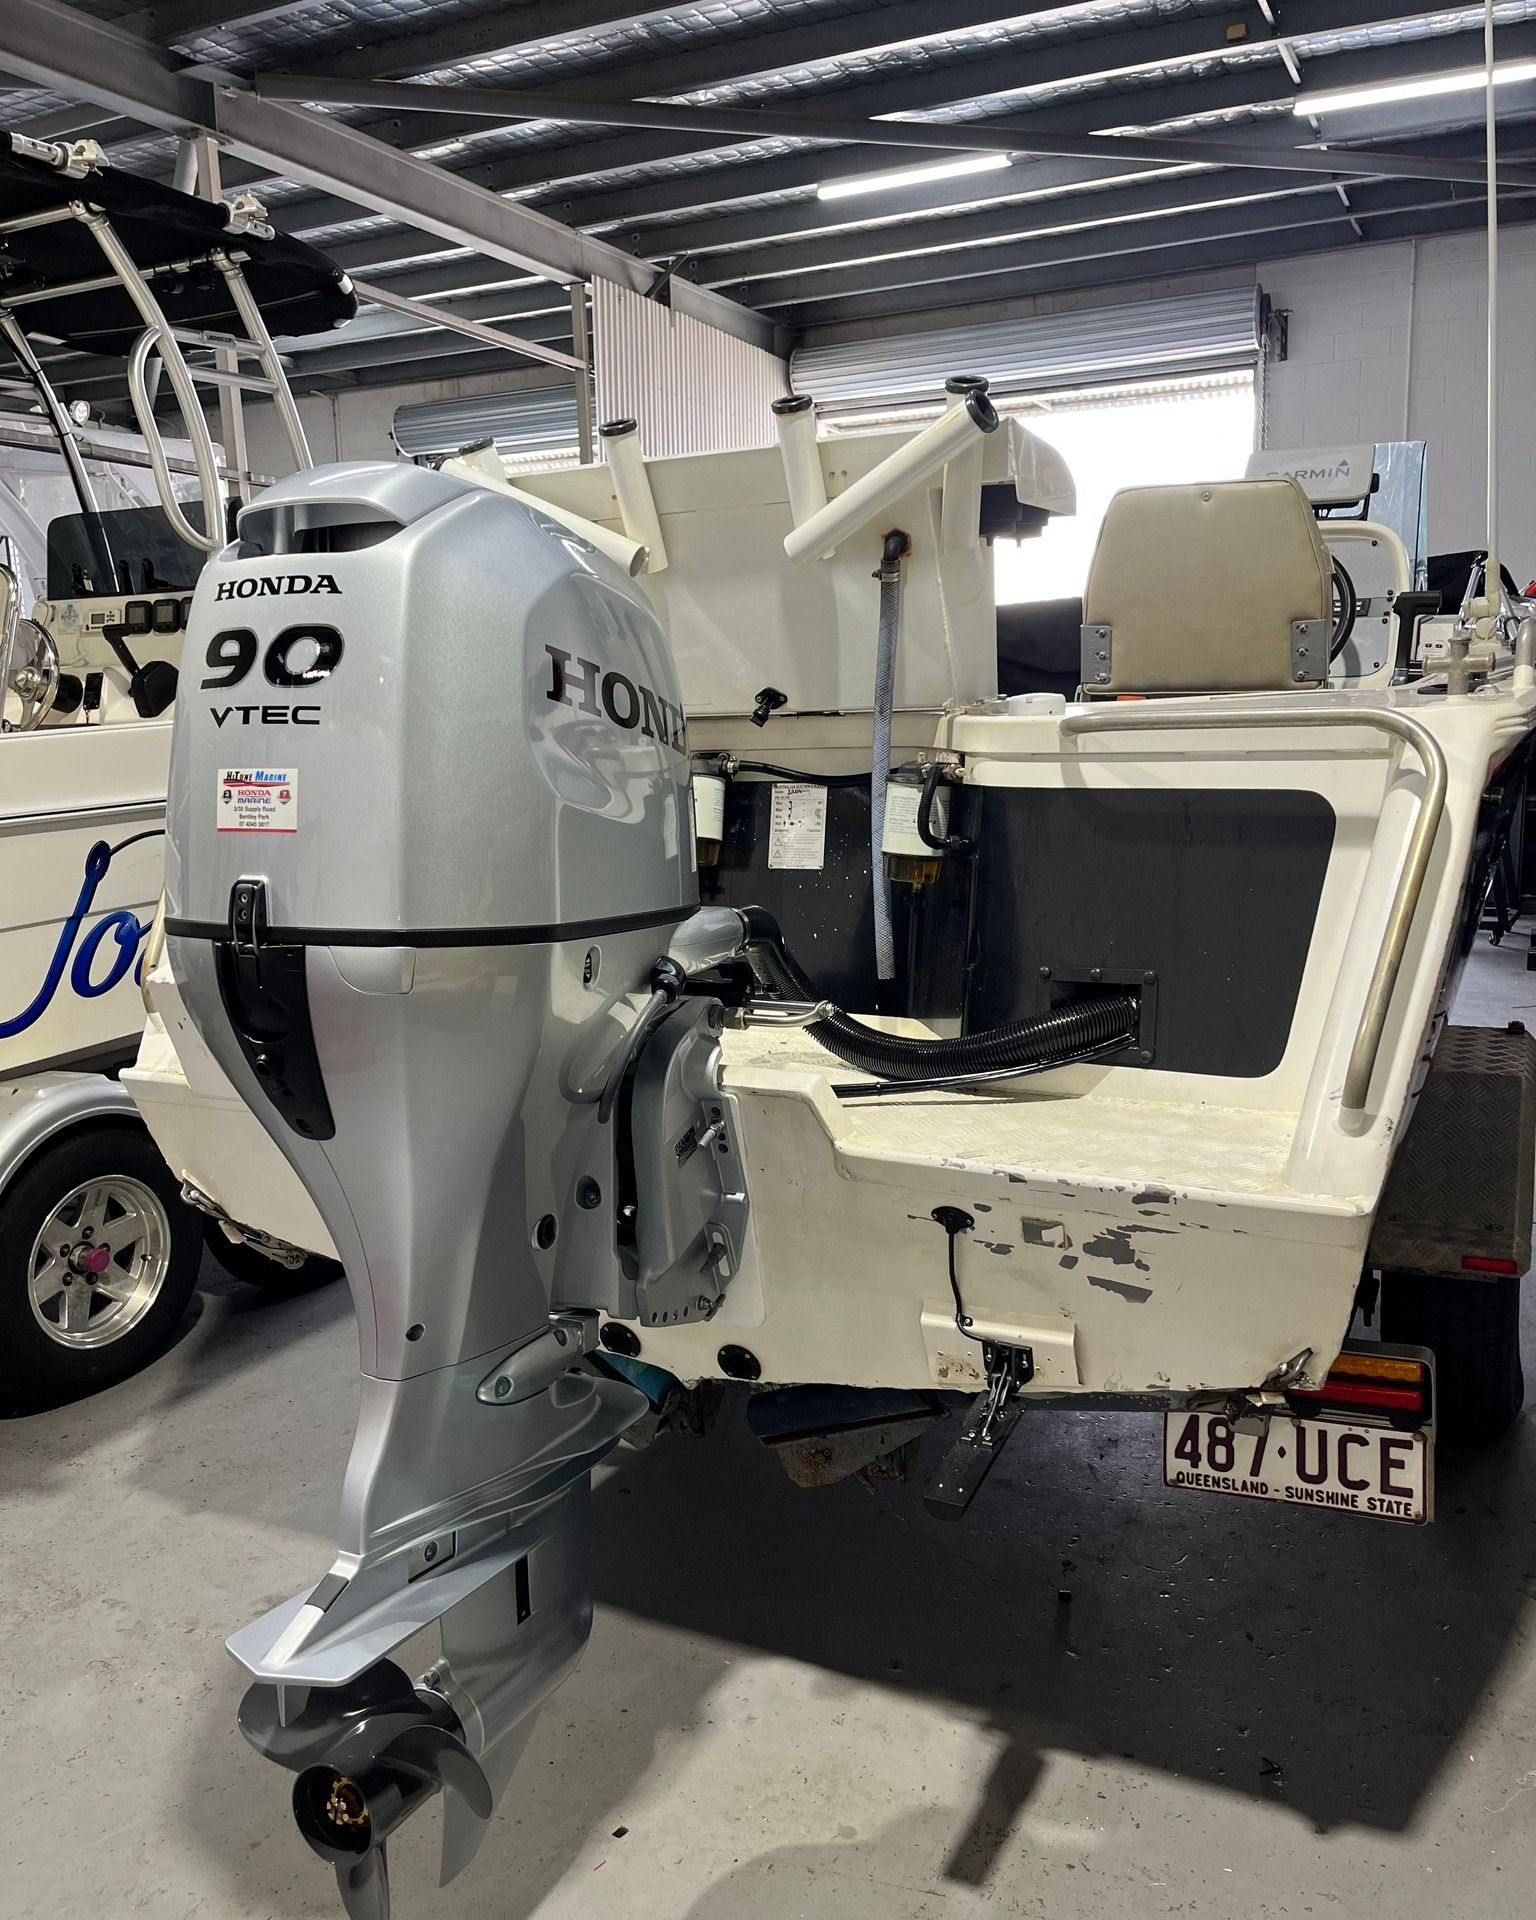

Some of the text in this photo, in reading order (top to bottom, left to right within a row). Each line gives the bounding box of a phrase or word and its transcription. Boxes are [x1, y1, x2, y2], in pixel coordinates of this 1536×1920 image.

[214, 574, 343, 602] HONDA
[200, 623, 346, 690] 90
[209, 705, 322, 729] VTEC
[1175, 1470, 1269, 1496] QUEENSLAND
[1284, 1485, 1360, 1510] SUNSHINE
[1366, 1496, 1413, 1517] STATE
